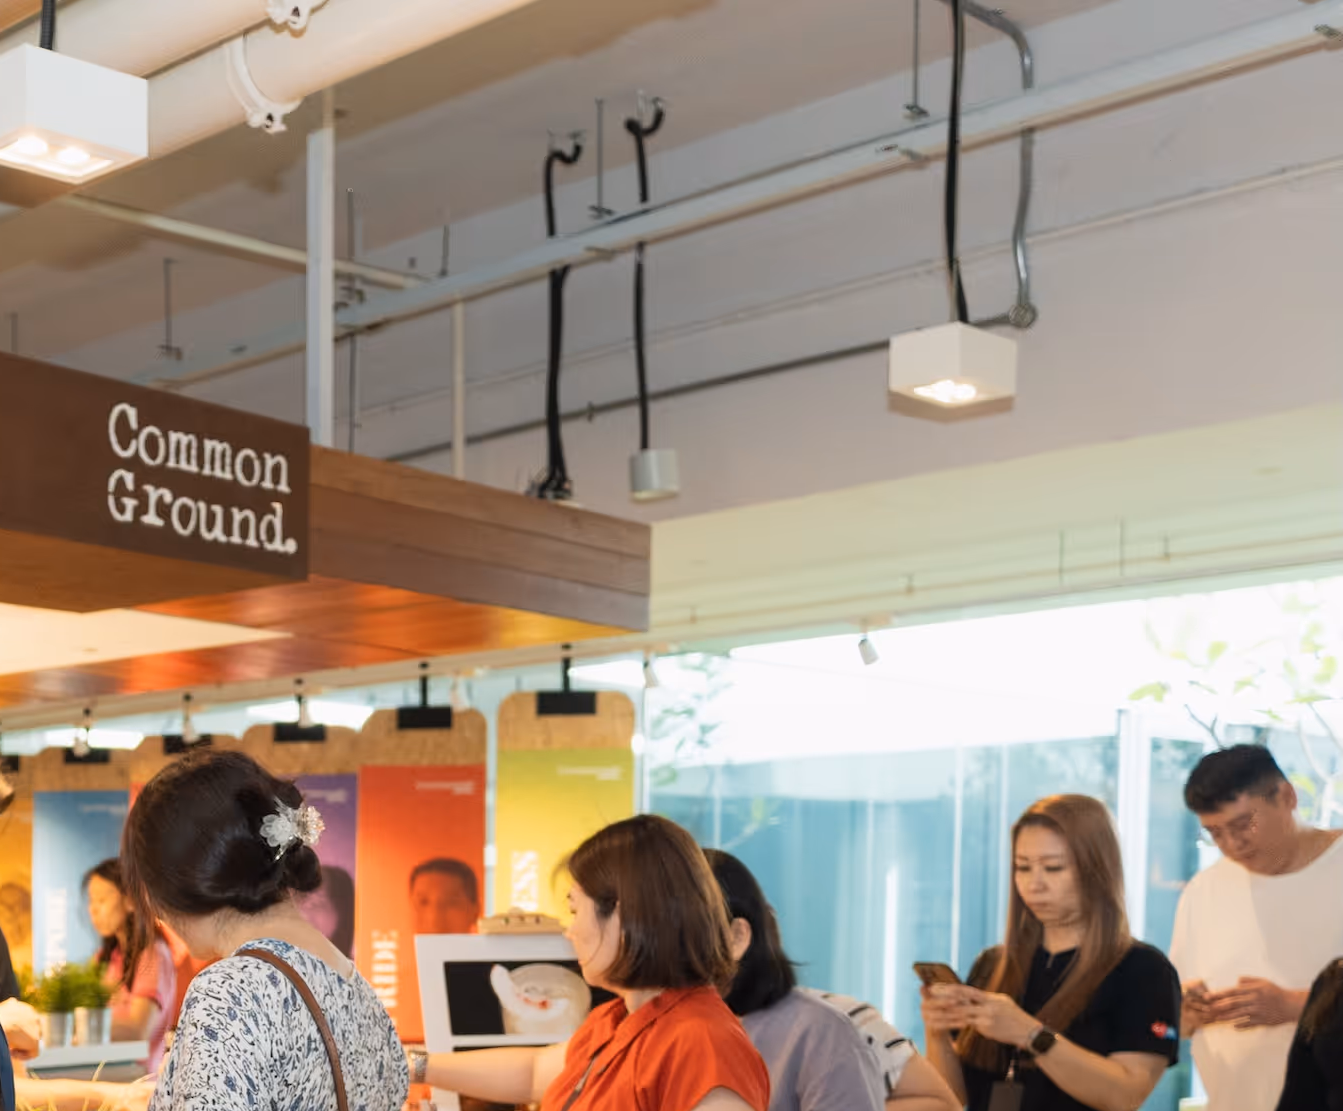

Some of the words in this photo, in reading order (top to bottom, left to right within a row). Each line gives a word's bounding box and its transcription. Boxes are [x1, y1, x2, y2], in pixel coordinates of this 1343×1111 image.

[108, 402, 292, 494] Common
[107, 468, 298, 555] Ground.
[371, 929, 398, 1026] RIDE
